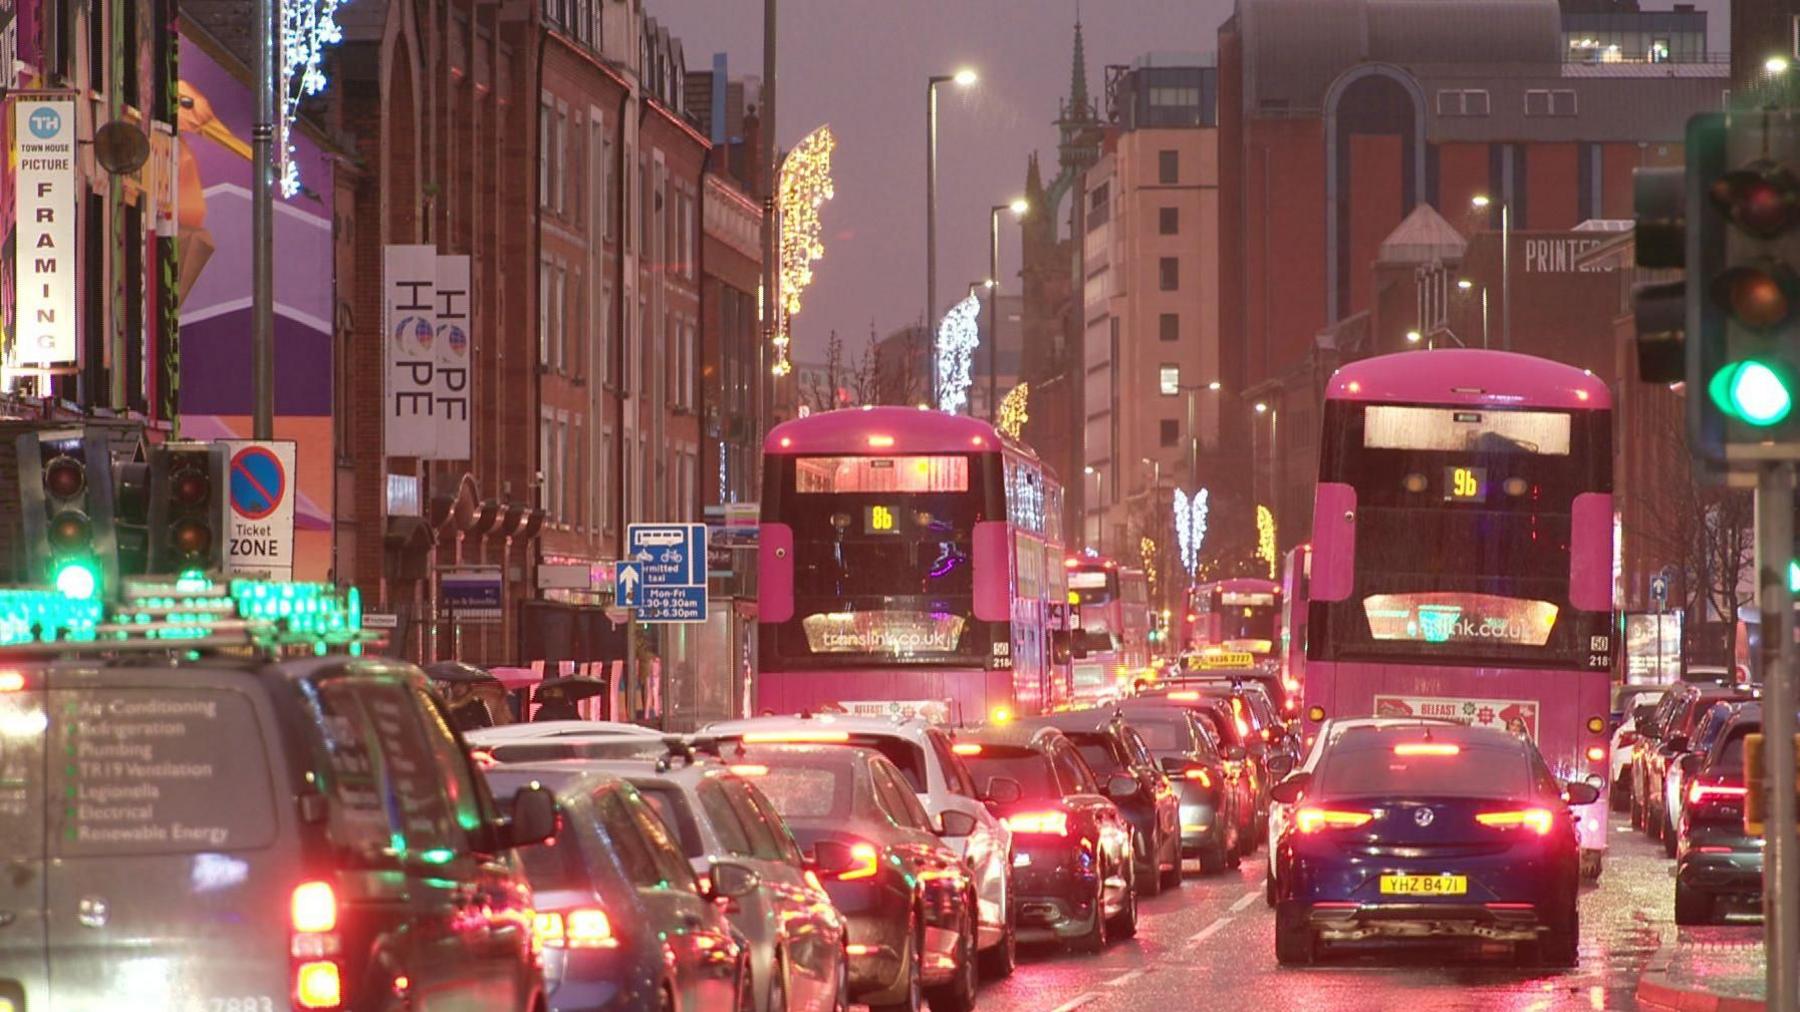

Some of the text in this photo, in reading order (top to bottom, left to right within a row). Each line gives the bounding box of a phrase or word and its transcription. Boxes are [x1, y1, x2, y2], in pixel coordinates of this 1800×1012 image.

[31, 116, 58, 131] TH
[21, 144, 70, 153] TOWN HOUSE
[21, 159, 69, 171] PICTURE
[1525, 239, 1614, 273] PRINTE
[35, 182, 56, 349] FRAMING
[395, 281, 433, 417] HOPE
[1454, 468, 1477, 497] 9b
[872, 505, 893, 530] 8b
[236, 524, 272, 537] Ticket
[230, 539, 278, 557] ZONE
[642, 563, 679, 573] rmitted
[648, 574, 666, 583] taxi
[650, 589, 686, 598] Mon-Fri
[643, 598, 698, 608] .30-9.30am
[638, 608, 699, 618] 3.-6.30pm
[1592, 636, 1608, 650] 50
[1589, 655, 1611, 667] 218
[109, 699, 217, 718] Conditioning
[1421, 703, 1456, 716] BELFAST
[79, 742, 153, 760] Plumbing
[126, 763, 213, 777] Ventilation
[80, 783, 160, 802] Legionella
[80, 804, 153, 820] Electrical
[79, 822, 229, 845] Renewable Energy
[1390, 877, 1458, 892] YHZ 8471
